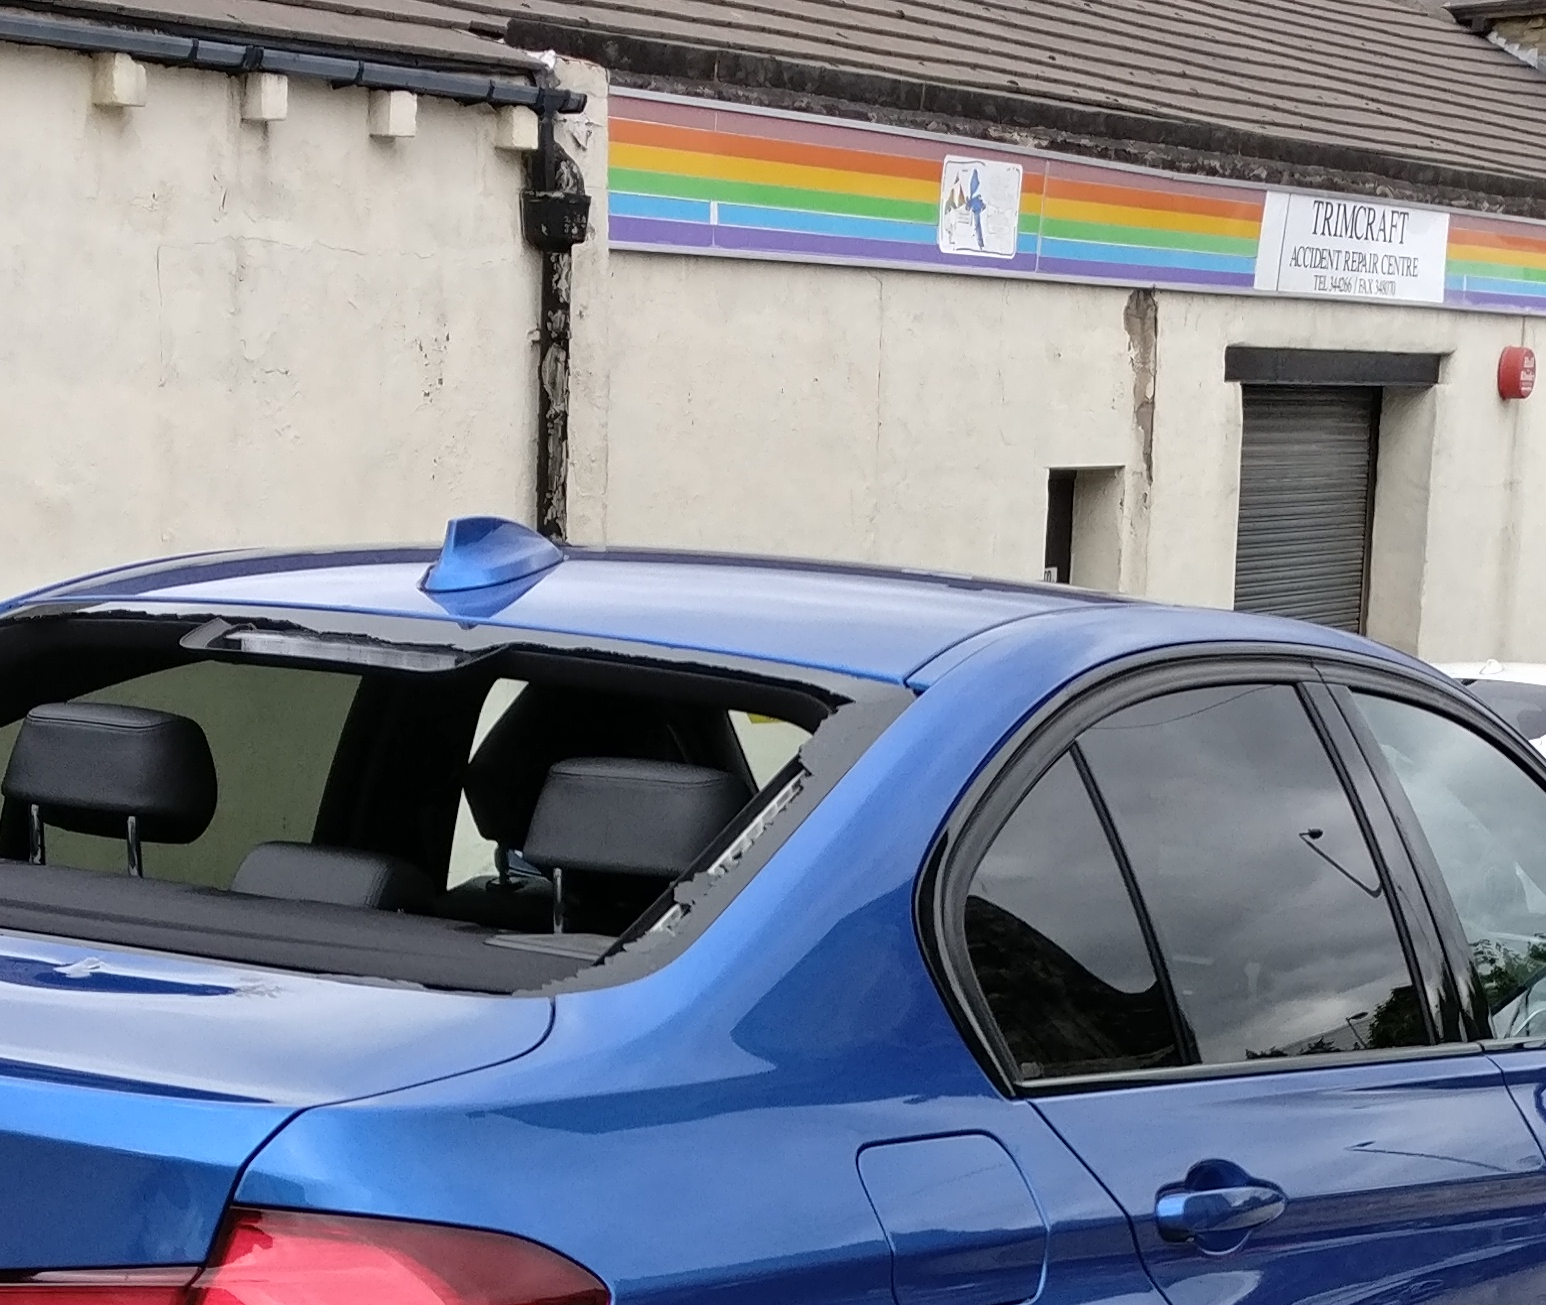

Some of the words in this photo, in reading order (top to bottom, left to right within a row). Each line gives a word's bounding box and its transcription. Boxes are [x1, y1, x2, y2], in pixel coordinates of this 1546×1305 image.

[1311, 200, 1409, 244] TRIMCRAFT
[1289, 245, 1342, 271] ACCIDENT
[1343, 250, 1378, 274] REPAIR
[1380, 253, 1419, 277] CENTRE
[1313, 274, 1327, 291] TEL
